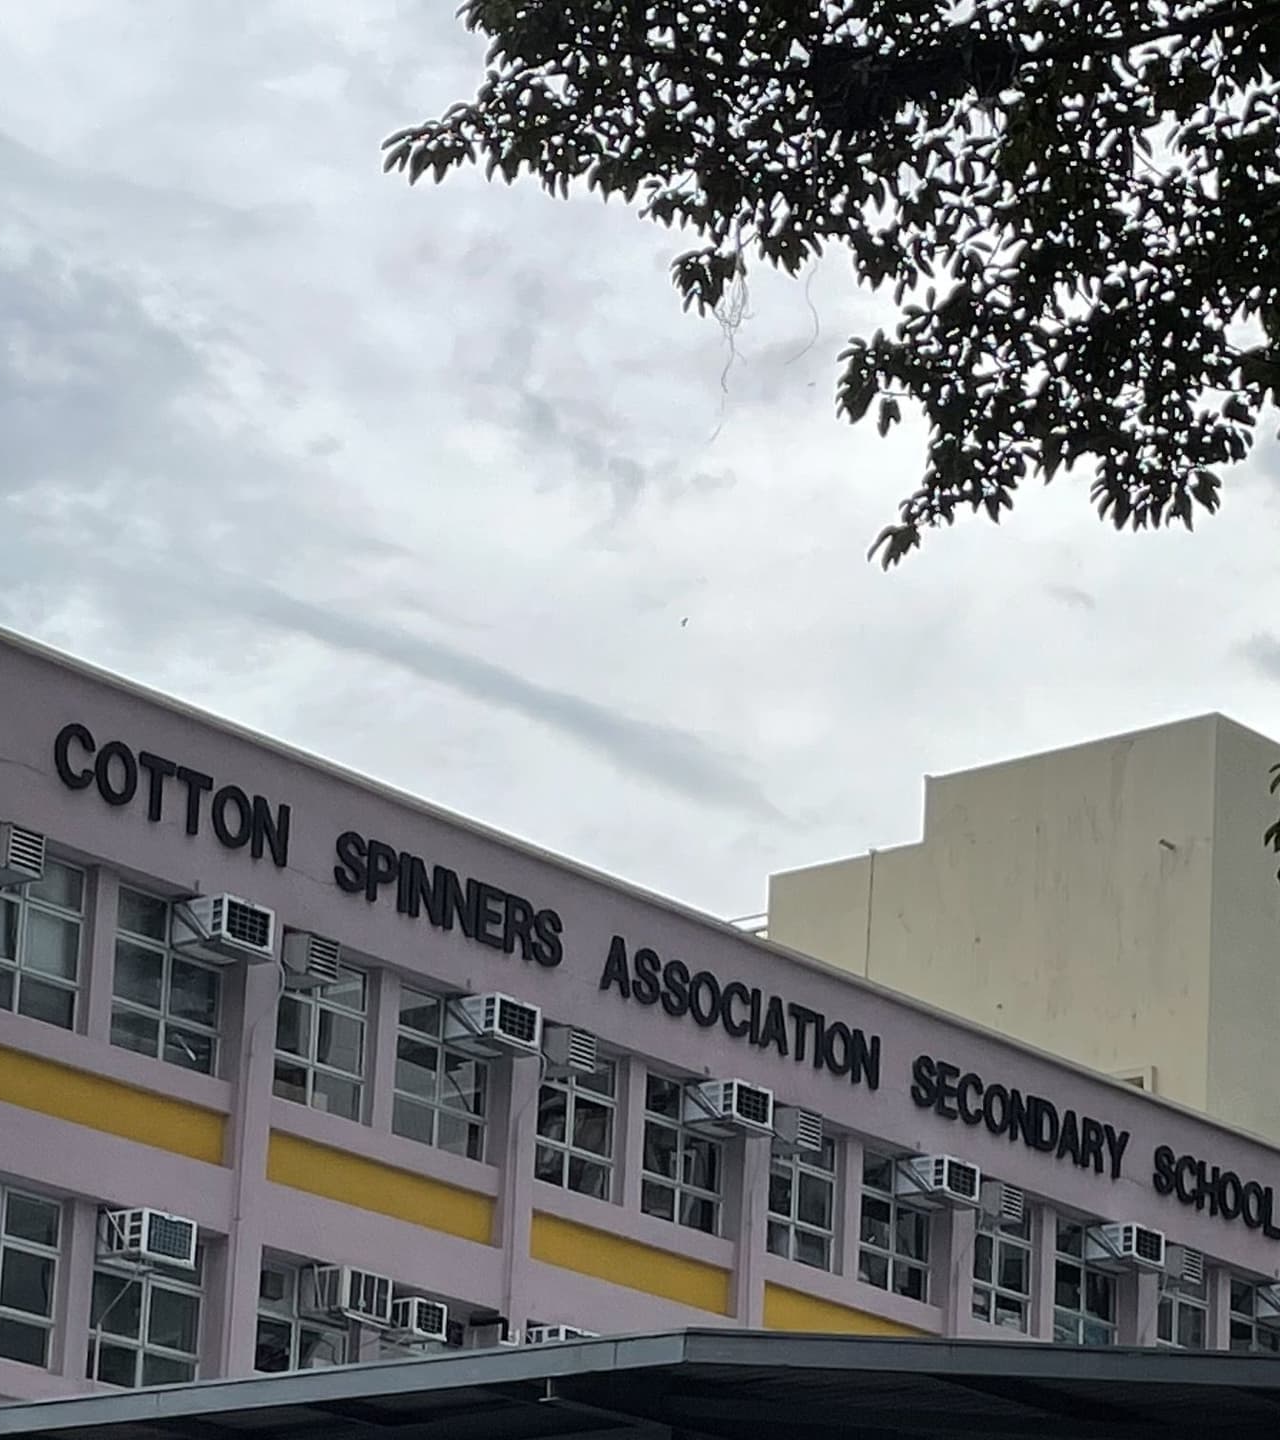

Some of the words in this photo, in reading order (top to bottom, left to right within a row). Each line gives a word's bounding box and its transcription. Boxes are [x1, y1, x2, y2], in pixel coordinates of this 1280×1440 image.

[53, 723, 291, 868] COTTON
[333, 831, 564, 968] SPINNERS
[599, 935, 881, 1090] ASSOCIATION
[910, 1054, 1130, 1179] SECONDARY
